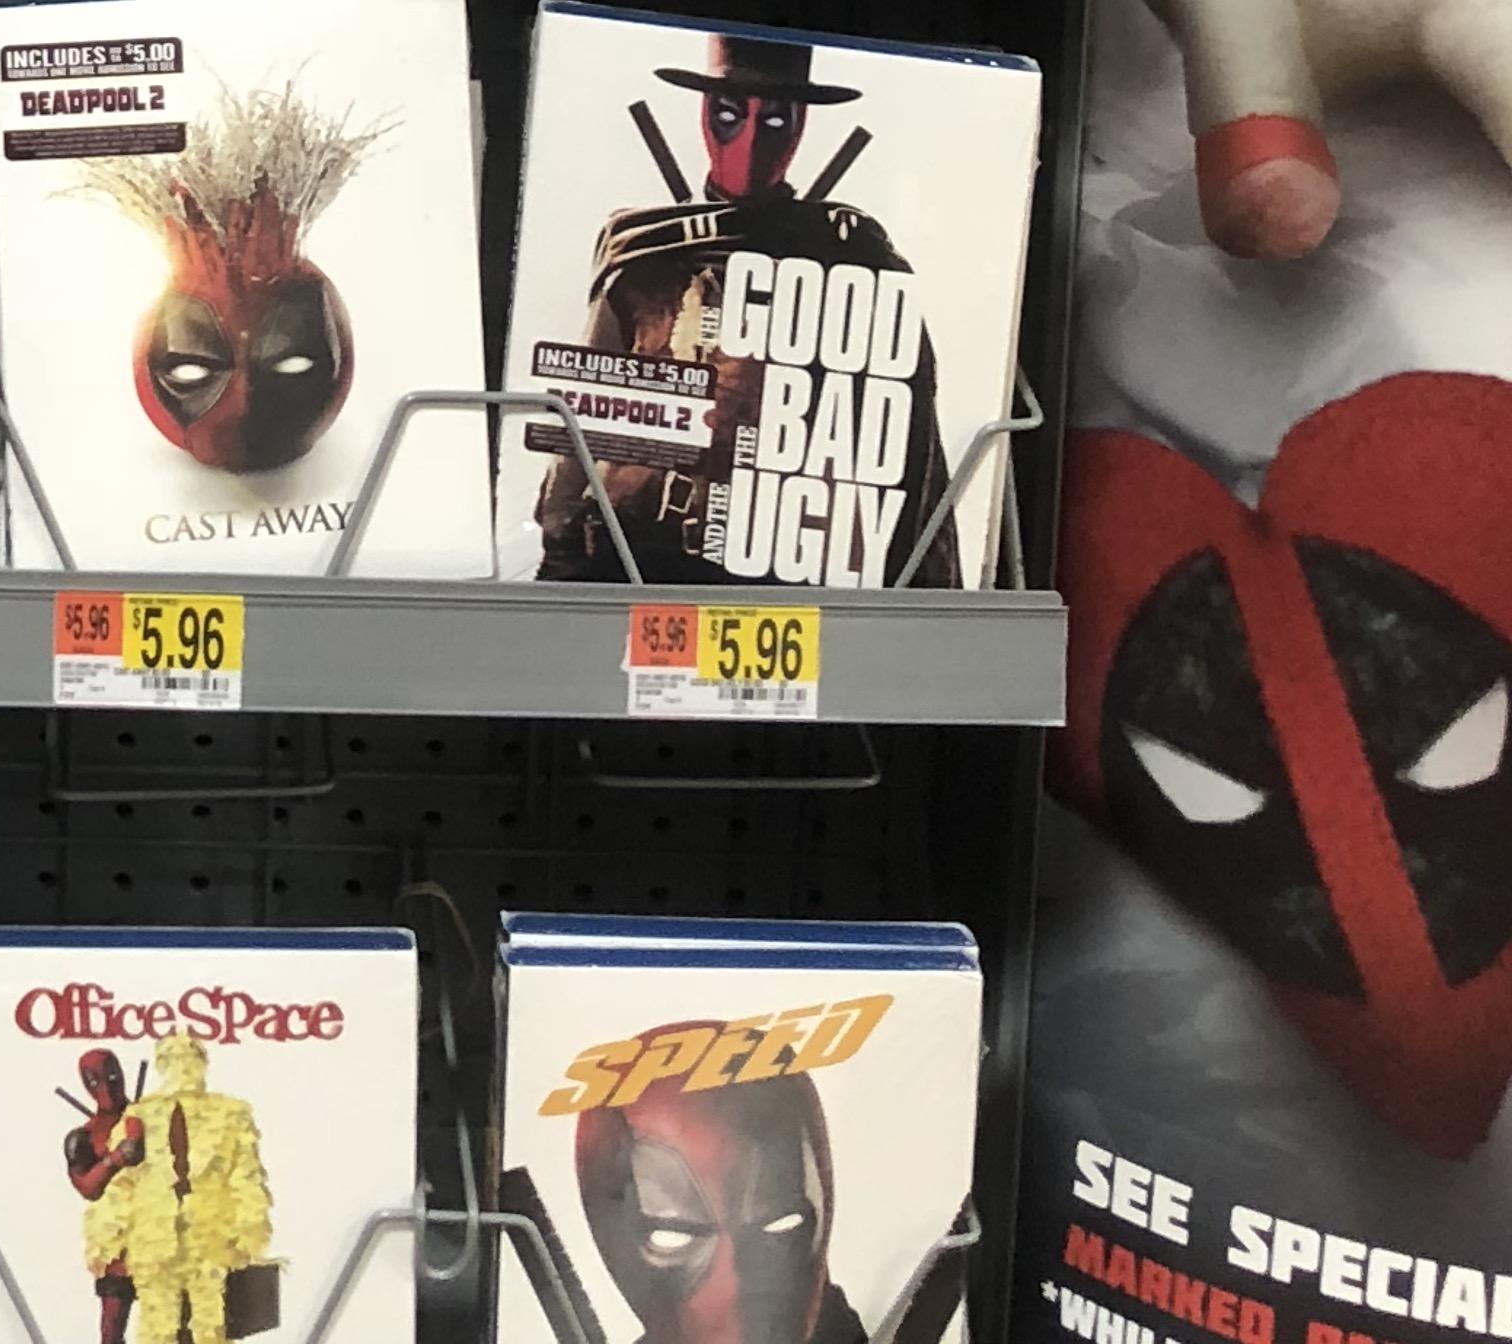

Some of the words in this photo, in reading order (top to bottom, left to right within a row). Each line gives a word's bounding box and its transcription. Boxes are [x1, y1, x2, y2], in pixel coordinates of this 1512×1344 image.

[6, 45, 106, 69] INCLUDES
[125, 43, 175, 63] $5.00
[20, 86, 147, 117] DEADPOOL
[149, 85, 165, 110] 2
[719, 250, 924, 379] GOOD
[538, 347, 639, 377] INCLUDES
[659, 362, 709, 387] $5.00
[675, 406, 692, 431] 2
[755, 363, 913, 486] BAD
[734, 424, 758, 468] THE
[144, 511, 237, 547] CAST
[249, 501, 357, 537] AWAY
[708, 482, 730, 526] THE
[702, 524, 726, 566] AND
[724, 467, 907, 589] UGLY
[64, 604, 110, 641] $5.96
[132, 607, 225, 669] $5.96
[641, 616, 688, 652] $5.96
[710, 618, 803, 681] $5.96
[15, 982, 176, 1040] Office
[178, 985, 345, 1043] Space
[538, 994, 894, 1117] SPEED
[1072, 1139, 1194, 1246] SEE
[1063, 1223, 1275, 1344] MARKED
